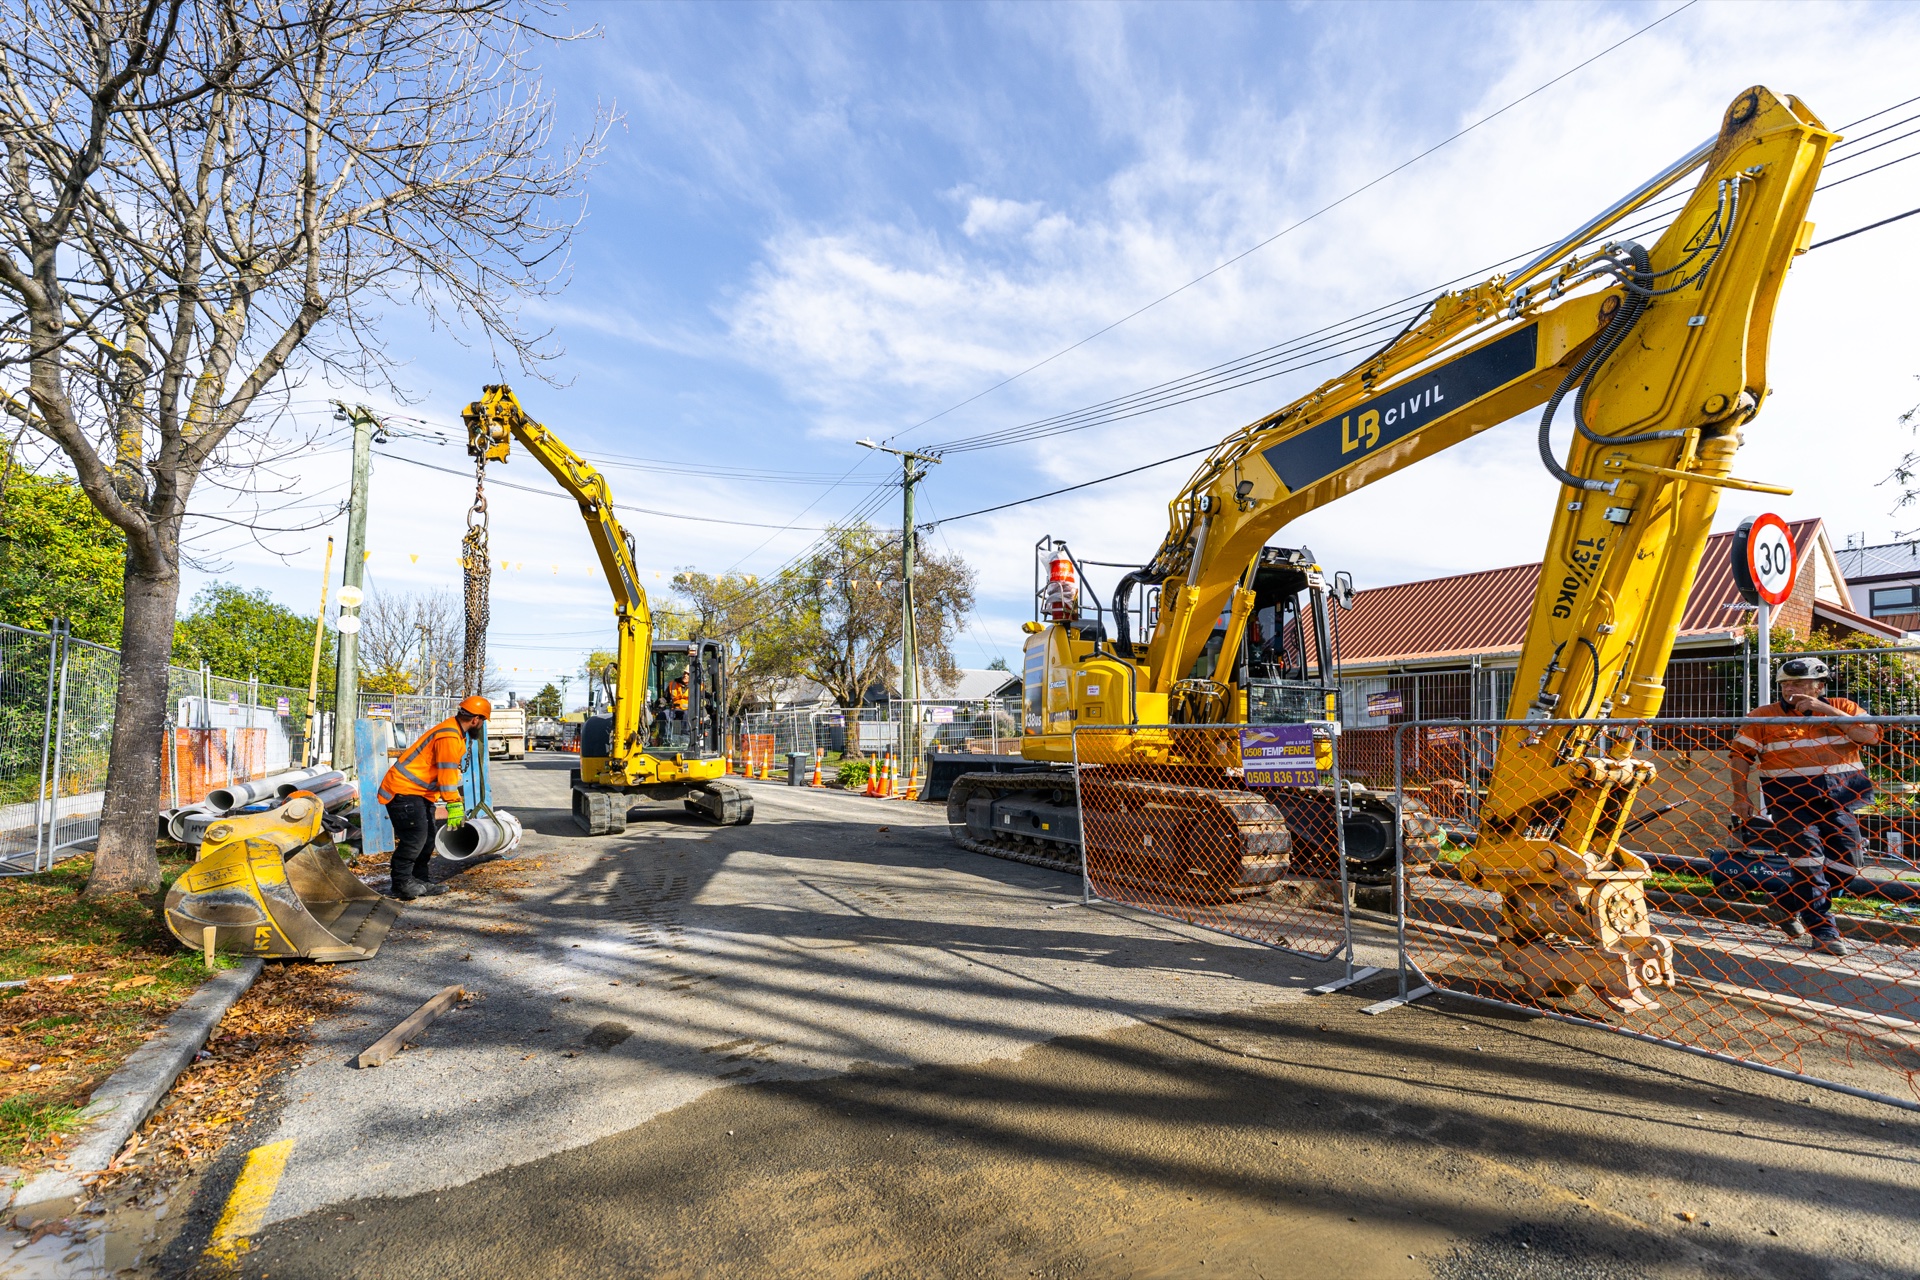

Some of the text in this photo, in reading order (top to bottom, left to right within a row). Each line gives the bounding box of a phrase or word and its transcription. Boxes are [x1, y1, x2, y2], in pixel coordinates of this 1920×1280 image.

[1342, 385, 1444, 455] LB CIVIL
[1760, 542, 1786, 575] 30
[1243, 745, 1311, 757] 0508TEMPFENCE
[1247, 770, 1315, 784] 0508 836 733
